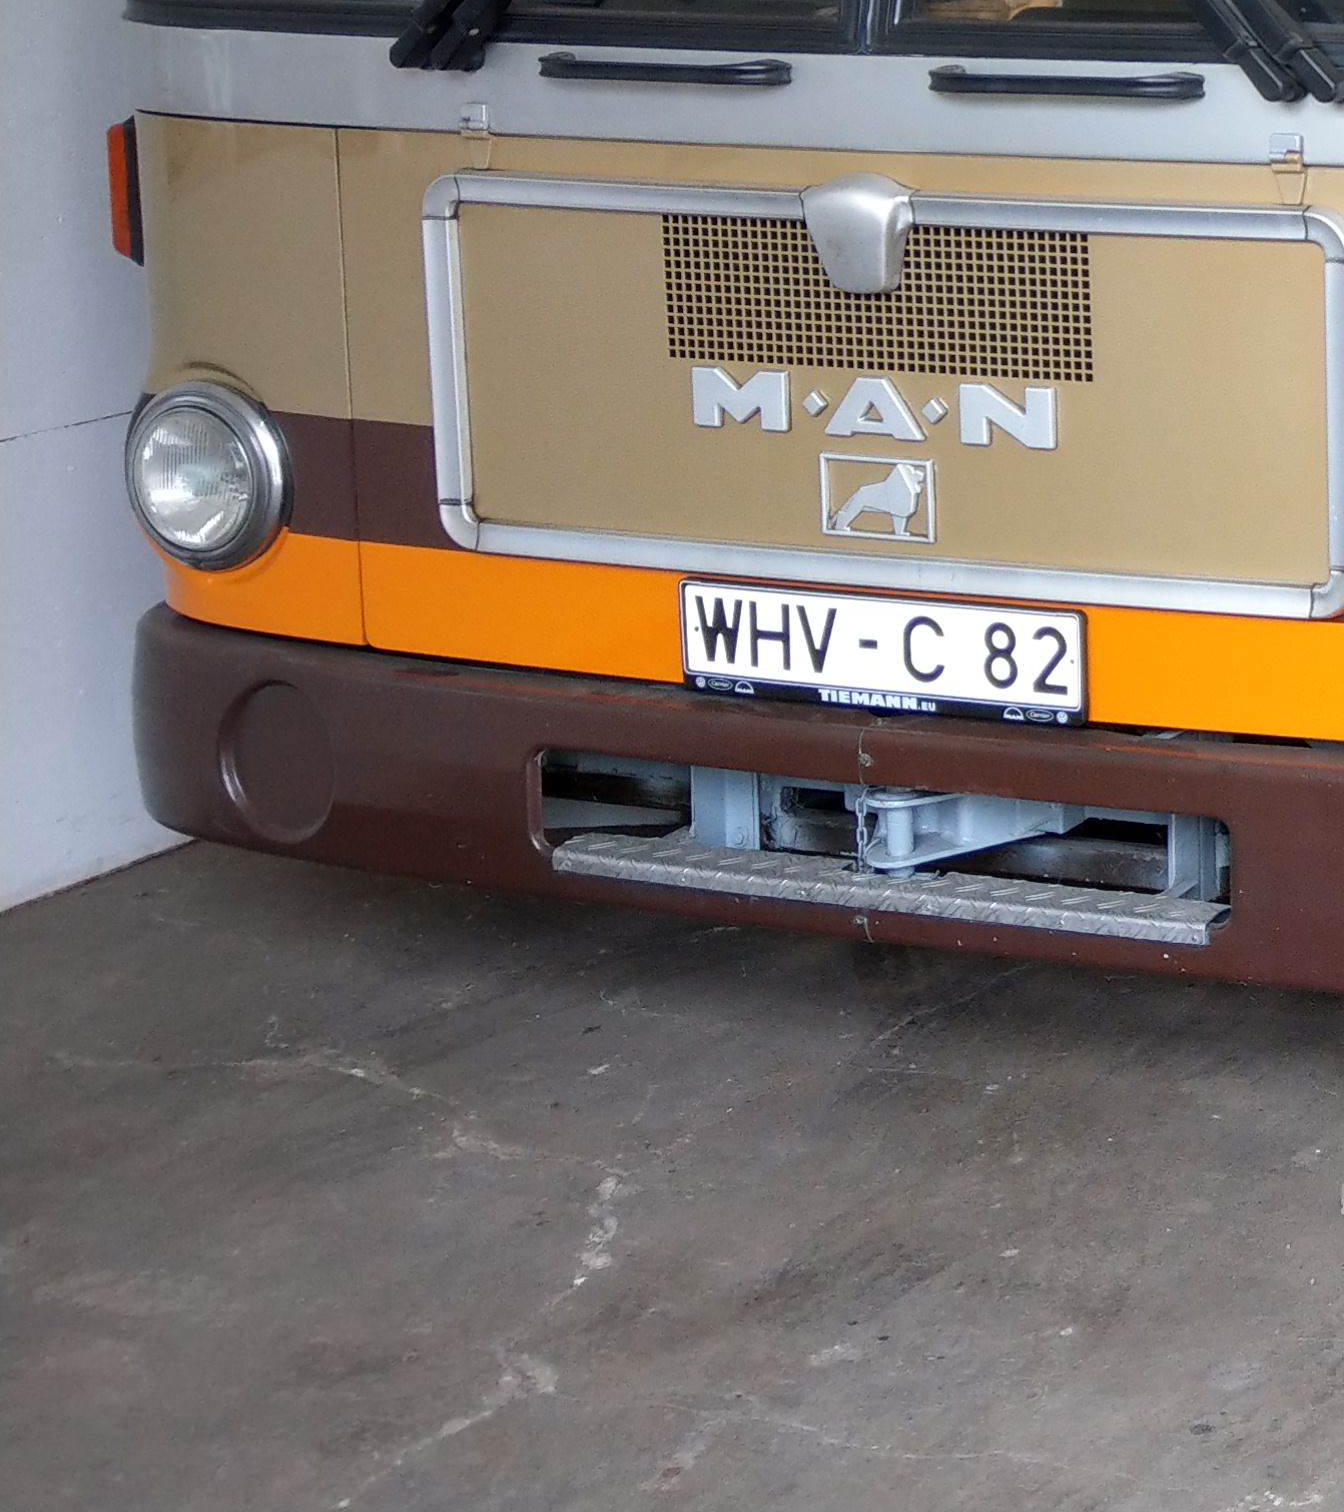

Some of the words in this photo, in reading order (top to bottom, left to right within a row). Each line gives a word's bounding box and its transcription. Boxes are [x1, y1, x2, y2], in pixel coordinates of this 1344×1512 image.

[694, 595, 838, 674] WHV
[903, 615, 945, 683] C
[983, 621, 1069, 696] 82
[817, 687, 937, 712] TIEMANN.EU
